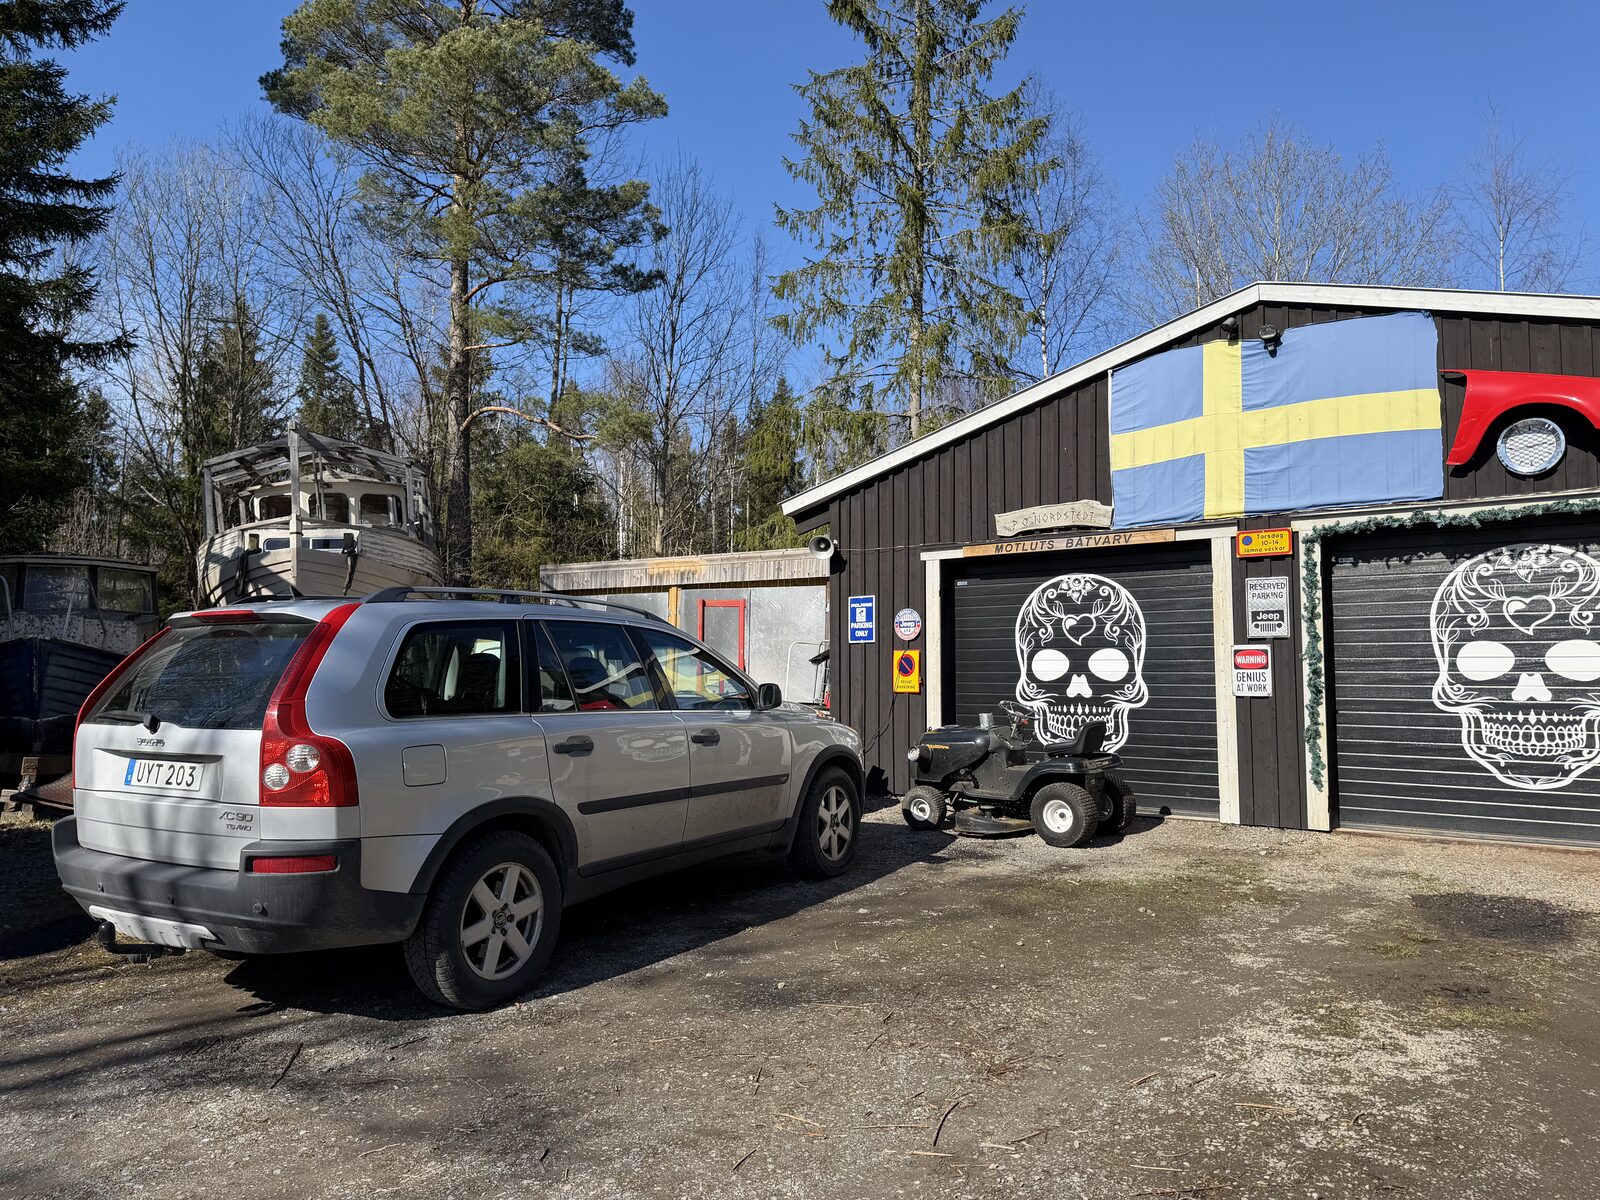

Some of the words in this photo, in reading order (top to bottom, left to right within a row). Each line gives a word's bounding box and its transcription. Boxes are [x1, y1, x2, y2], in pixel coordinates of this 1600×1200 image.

[995, 540, 1055, 554] MOTLUTS
[1249, 582, 1286, 591] RESERVED
[1252, 592, 1284, 600] PARKING
[1256, 612, 1280, 621] Jeep
[855, 630, 869, 638] ONLY
[1235, 655, 1267, 664] WARNING
[1236, 671, 1267, 683] GENIUS
[1236, 684, 1245, 692] AT
[1247, 683, 1268, 692] WORK
[136, 762, 164, 785] UYT
[165, 764, 197, 788] 203
